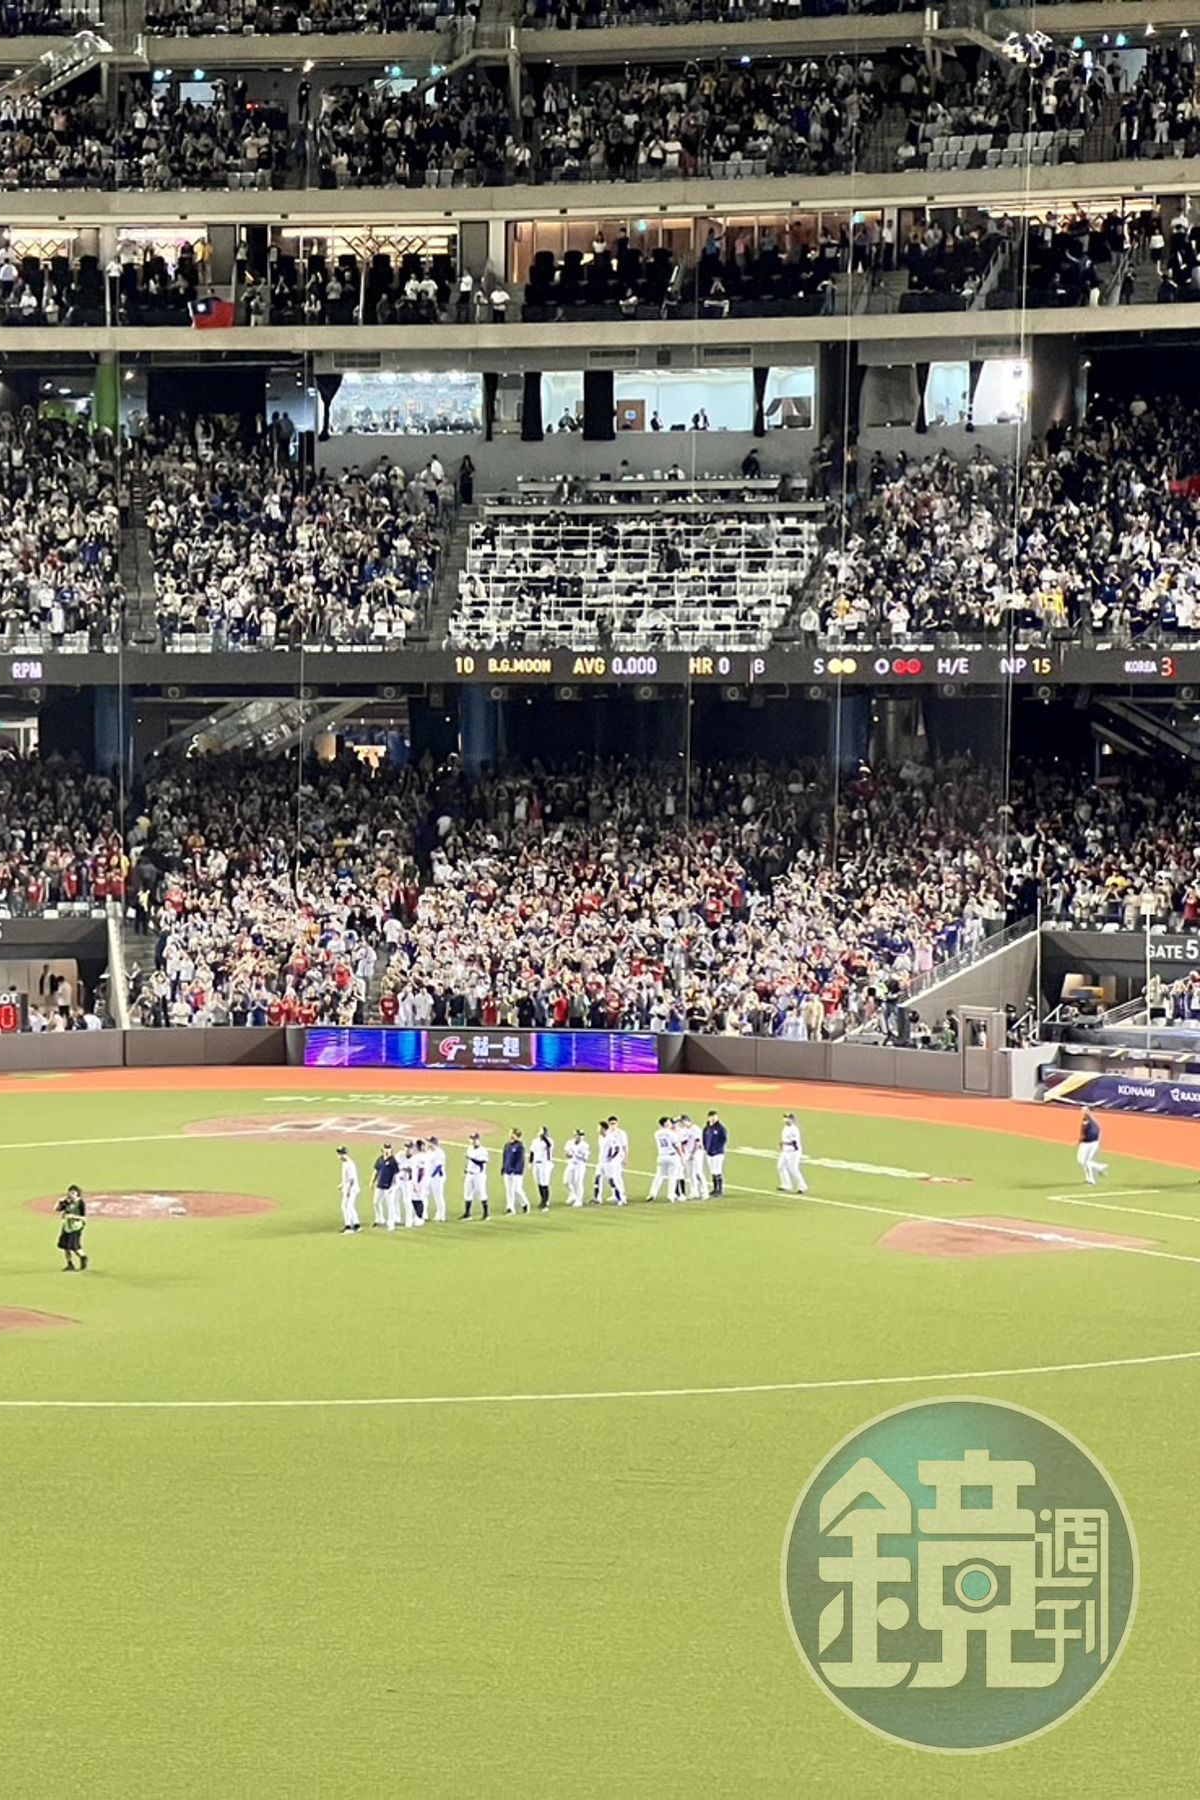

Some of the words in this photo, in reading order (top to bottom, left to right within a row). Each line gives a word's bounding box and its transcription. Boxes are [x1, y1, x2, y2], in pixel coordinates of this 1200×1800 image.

[12, 662, 42, 678] RPM
[456, 657, 474, 674] 10
[488, 658, 551, 673] B.G.MOON
[573, 657, 605, 674] AVG
[612, 657, 657, 674] 0.000
[689, 657, 713, 674] HR
[719, 657, 730, 674] 0
[813, 658, 824, 674] S
[938, 658, 969, 675] H/E
[1000, 658, 1027, 674] NP
[1033, 658, 1051, 673] 15
[1124, 660, 1157, 673] KOREA
[1161, 657, 1174, 676] 3
[1148, 944, 1183, 959] GATE
[1186, 938, 1199, 960] 5
[1118, 1084, 1156, 1098] KONAMI
